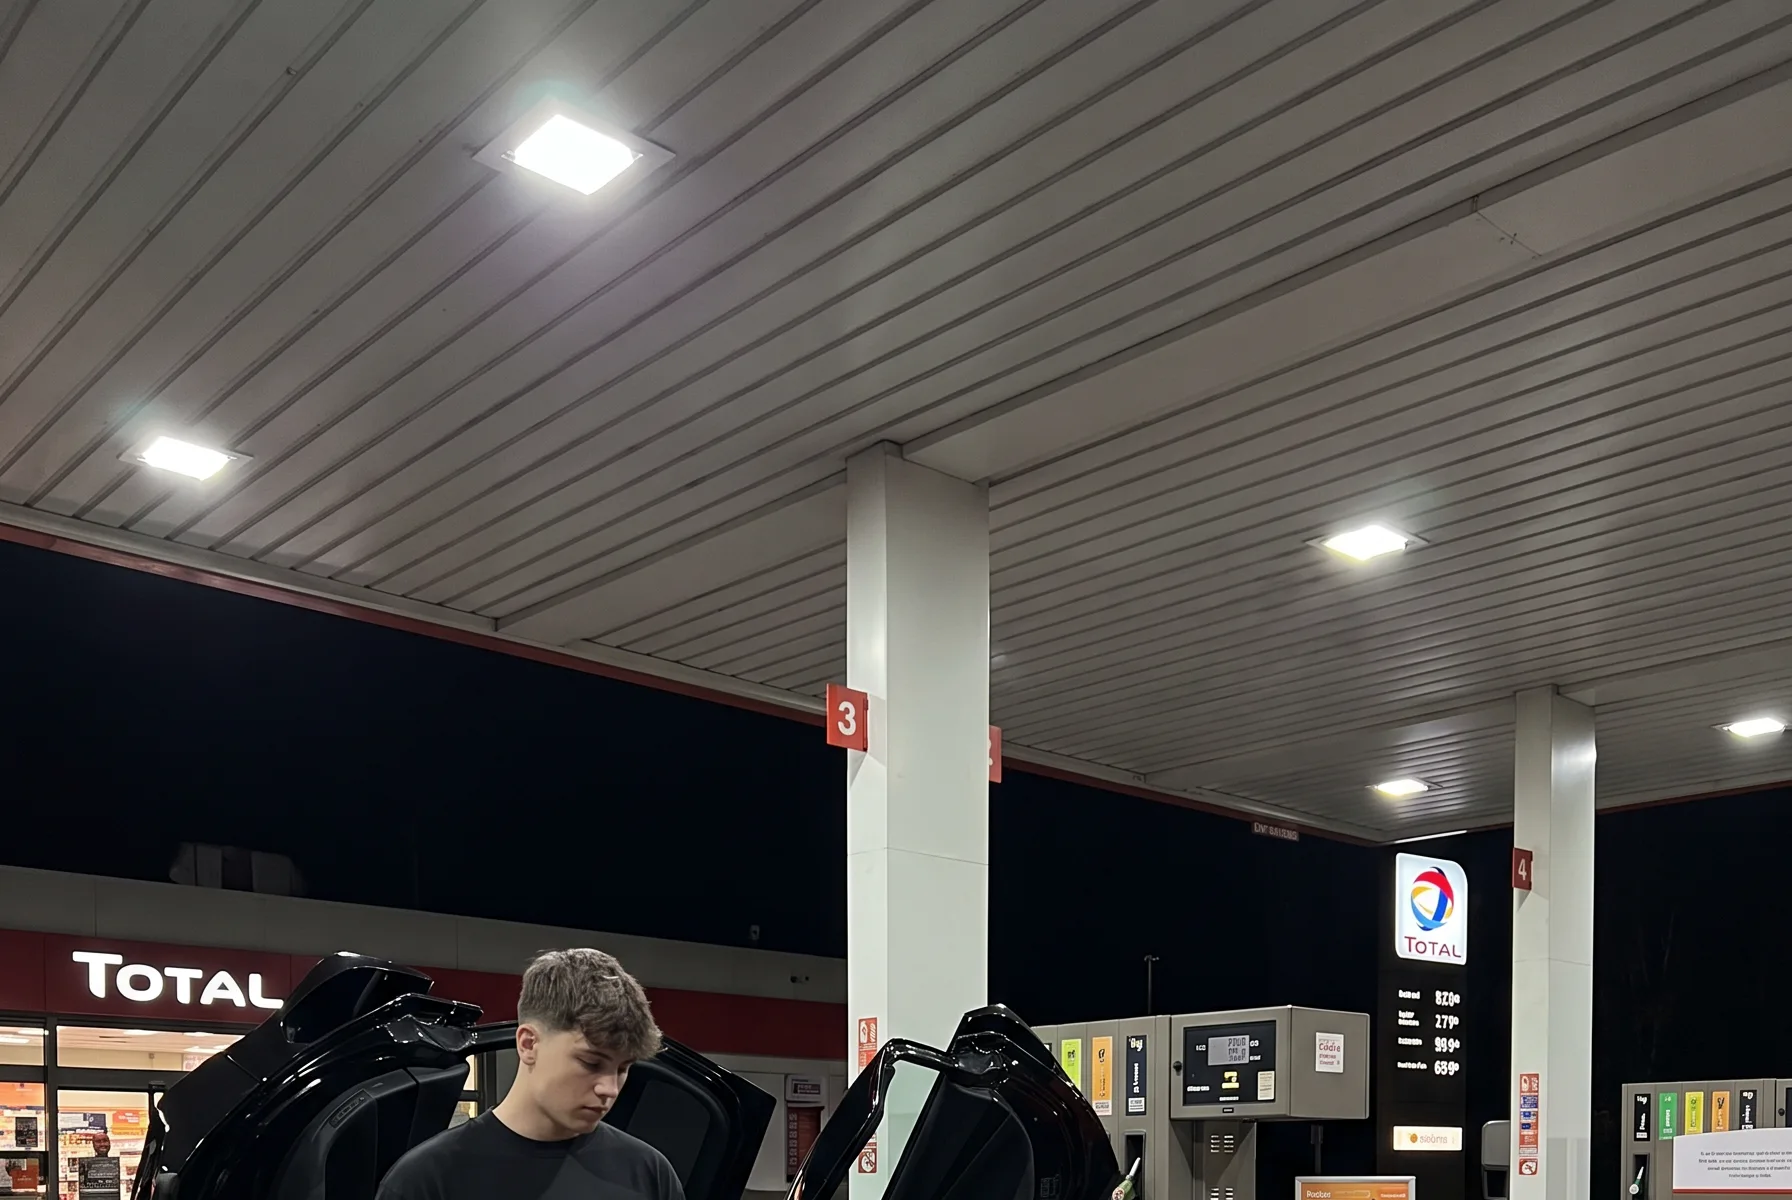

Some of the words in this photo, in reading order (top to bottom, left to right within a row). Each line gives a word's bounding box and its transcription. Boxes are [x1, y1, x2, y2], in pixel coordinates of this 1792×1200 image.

[837, 700, 857, 736] 3
[1517, 858, 1528, 881] 4
[1404, 935, 1462, 959] TOTAL
[72, 951, 285, 1009] TOTAL
